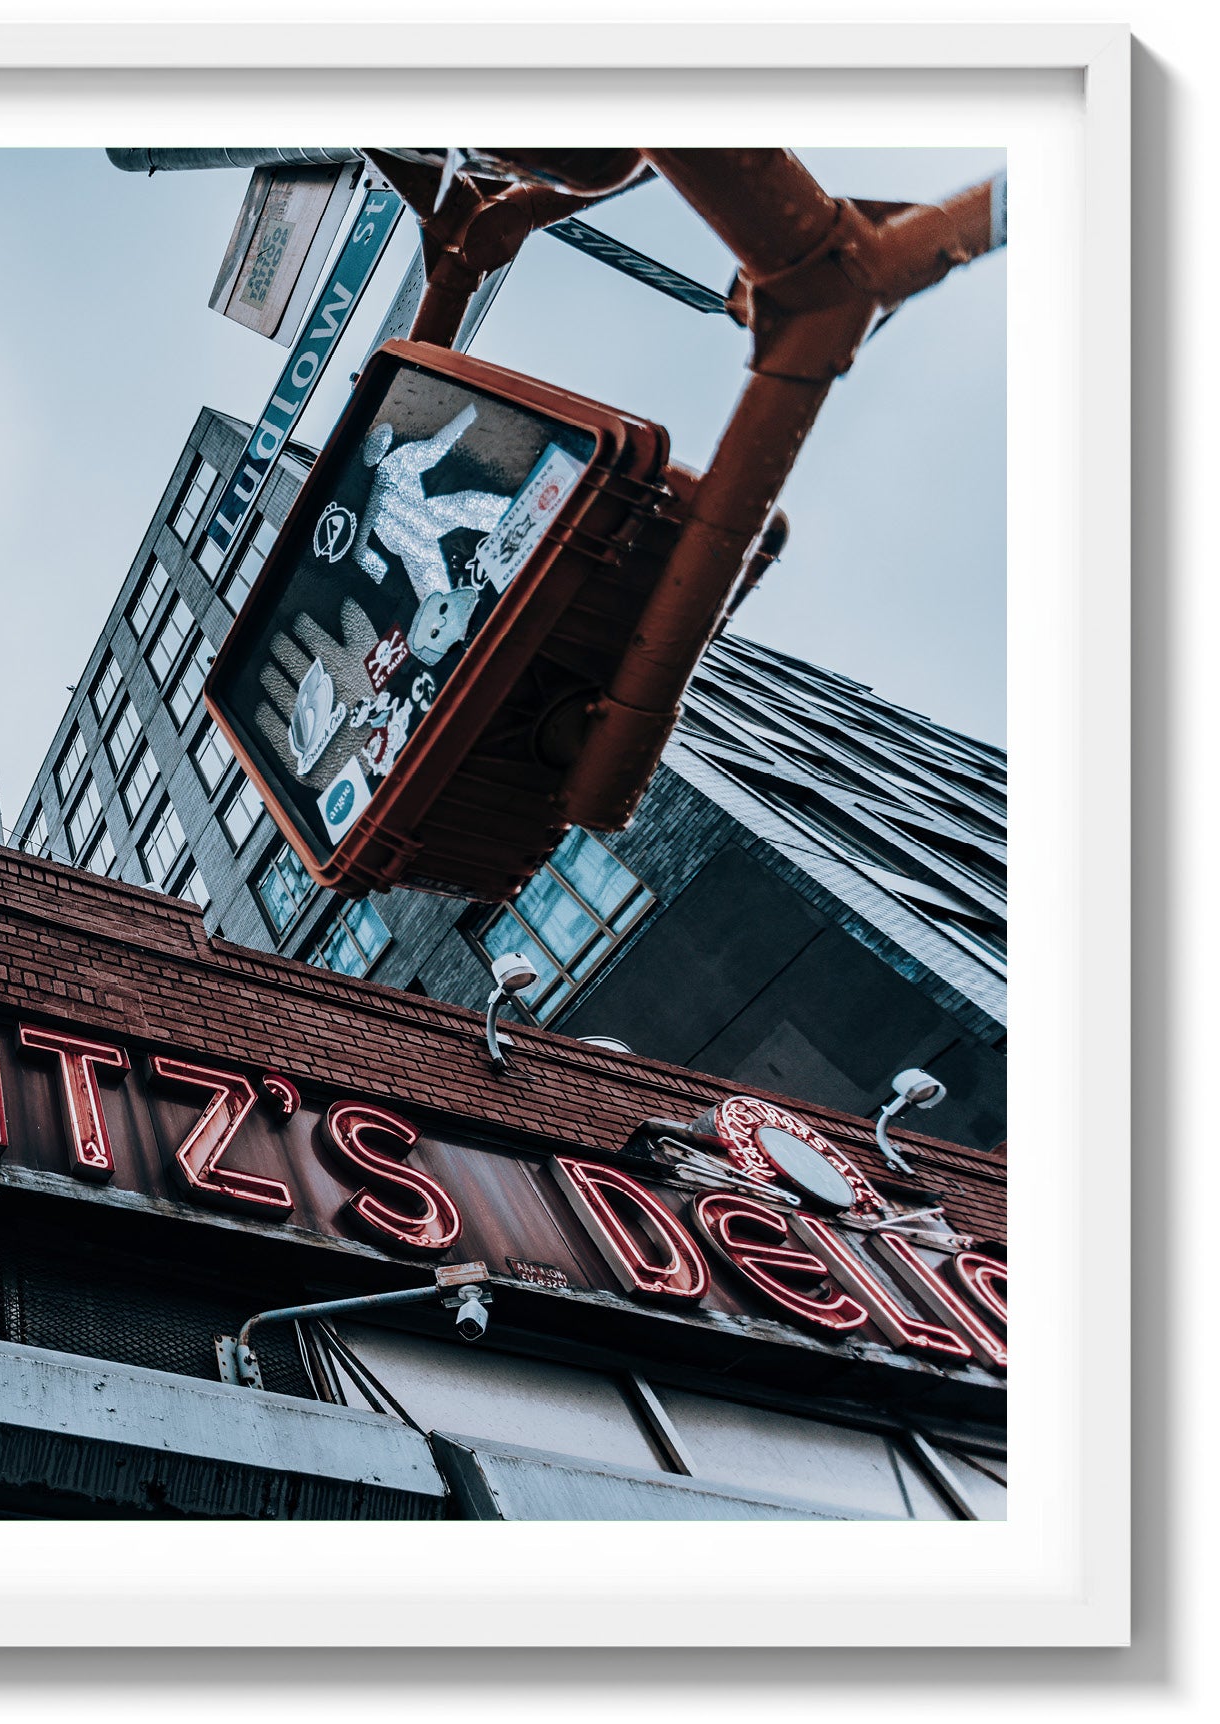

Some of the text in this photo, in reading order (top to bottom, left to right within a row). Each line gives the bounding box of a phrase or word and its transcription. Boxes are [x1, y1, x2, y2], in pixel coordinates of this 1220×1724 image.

[249, 226, 282, 300] TATTOO
[258, 228, 288, 303] SHOP
[214, 279, 355, 537] Ludlow
[386, 647, 408, 675] PAULI
[330, 784, 351, 820] argue
